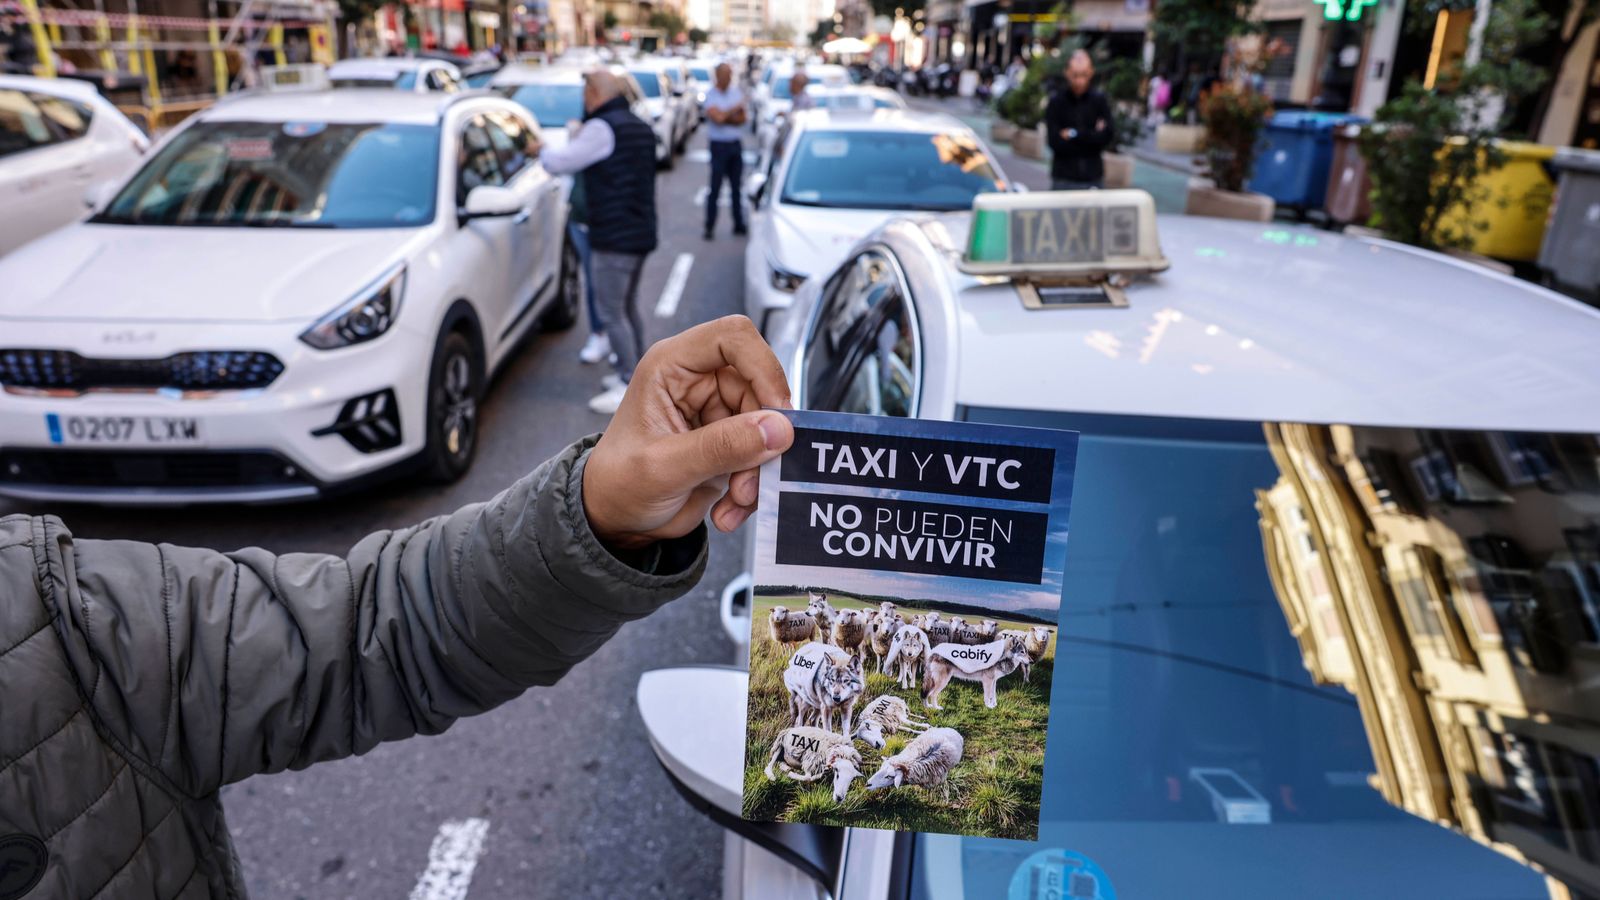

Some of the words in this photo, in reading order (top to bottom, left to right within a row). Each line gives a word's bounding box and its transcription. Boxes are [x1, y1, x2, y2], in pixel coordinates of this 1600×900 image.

[1017, 208, 1098, 254] TAXI
[67, 416, 135, 440] 0207
[144, 416, 199, 441] LXW
[811, 441, 898, 479] TAXI
[911, 451, 933, 481] Y
[943, 454, 1023, 490] VTC
[809, 502, 863, 530] NO
[875, 507, 1013, 544] PUEDEN
[822, 530, 996, 568] CONVIVIR
[789, 619, 806, 627] TAXI
[933, 626, 950, 637] TAXI
[963, 630, 981, 639] TAXI
[793, 654, 816, 670] Uber
[950, 649, 993, 664] cabify
[872, 699, 892, 716] TAXI
[791, 733, 821, 753] TAXI
